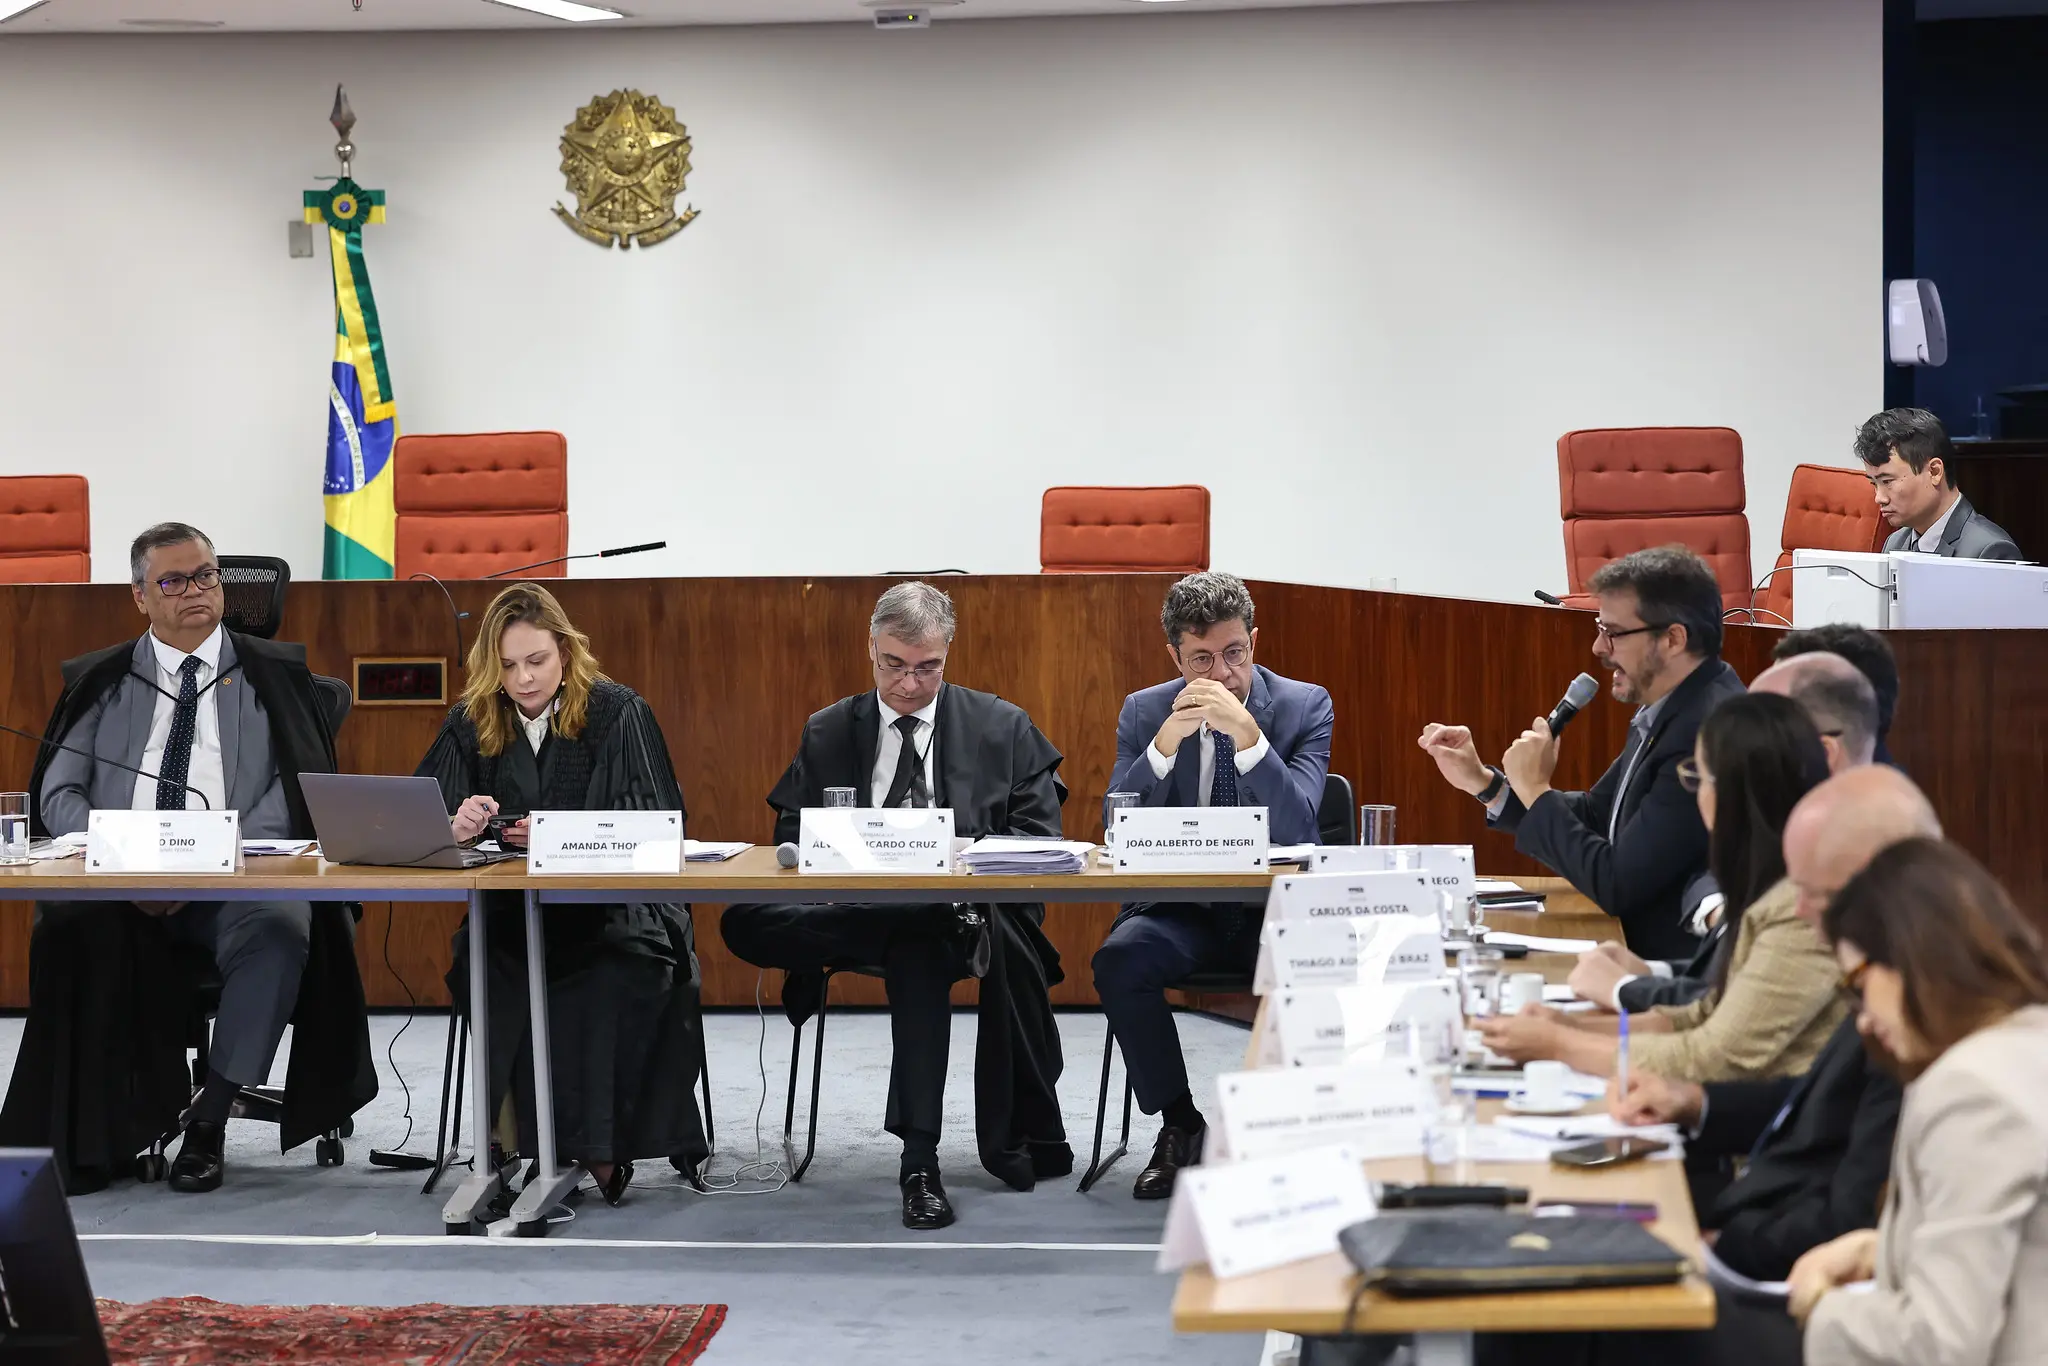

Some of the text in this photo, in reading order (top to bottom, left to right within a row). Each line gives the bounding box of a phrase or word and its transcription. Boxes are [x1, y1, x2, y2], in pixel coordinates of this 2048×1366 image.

[169, 838, 196, 847] DINO
[561, 842, 608, 850] AMANDA
[865, 840, 906, 849] ICARDO
[909, 840, 938, 849] CRUZ
[1126, 838, 1254, 849] JOÃO ALBERTO DE NEGRI
[1309, 904, 1410, 917] CARLOS DA COSTA
[1289, 956, 1335, 970] THIAGO
